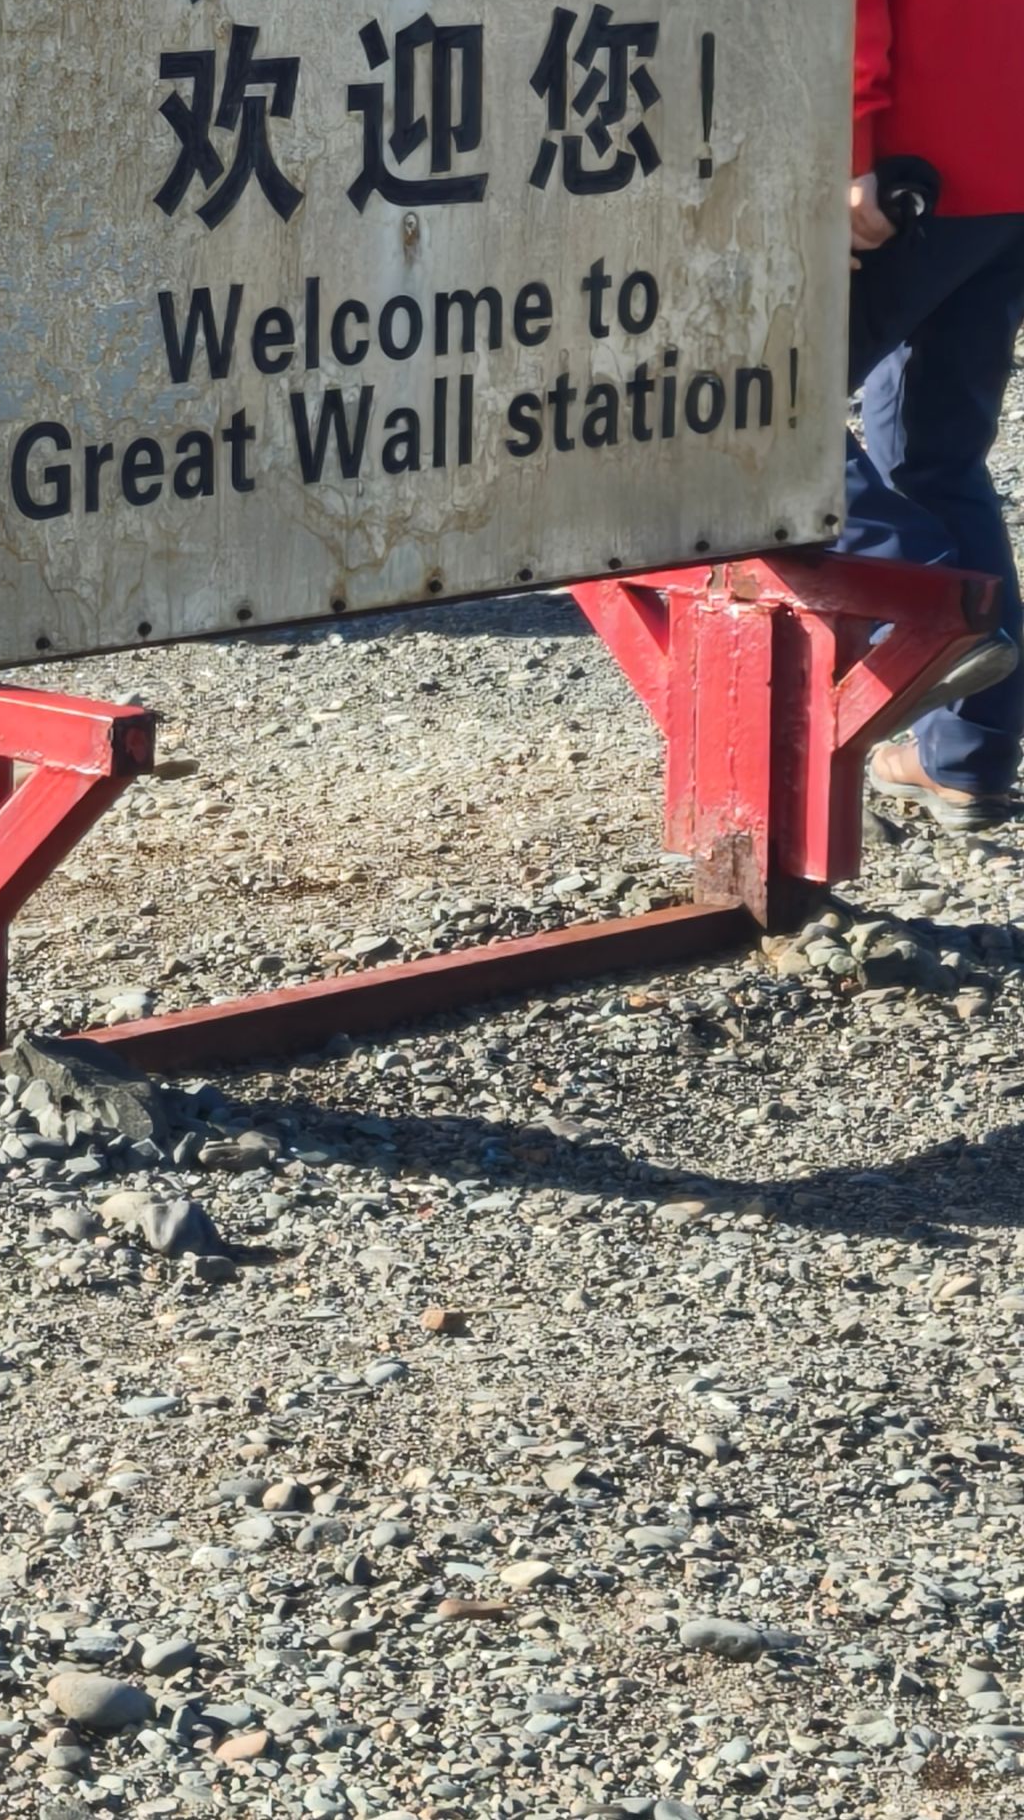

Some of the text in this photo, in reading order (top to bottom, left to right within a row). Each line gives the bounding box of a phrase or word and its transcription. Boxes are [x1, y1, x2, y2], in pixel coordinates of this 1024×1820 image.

[157, 257, 661, 383] Welcome to
[10, 347, 799, 520] Great Wall station!
